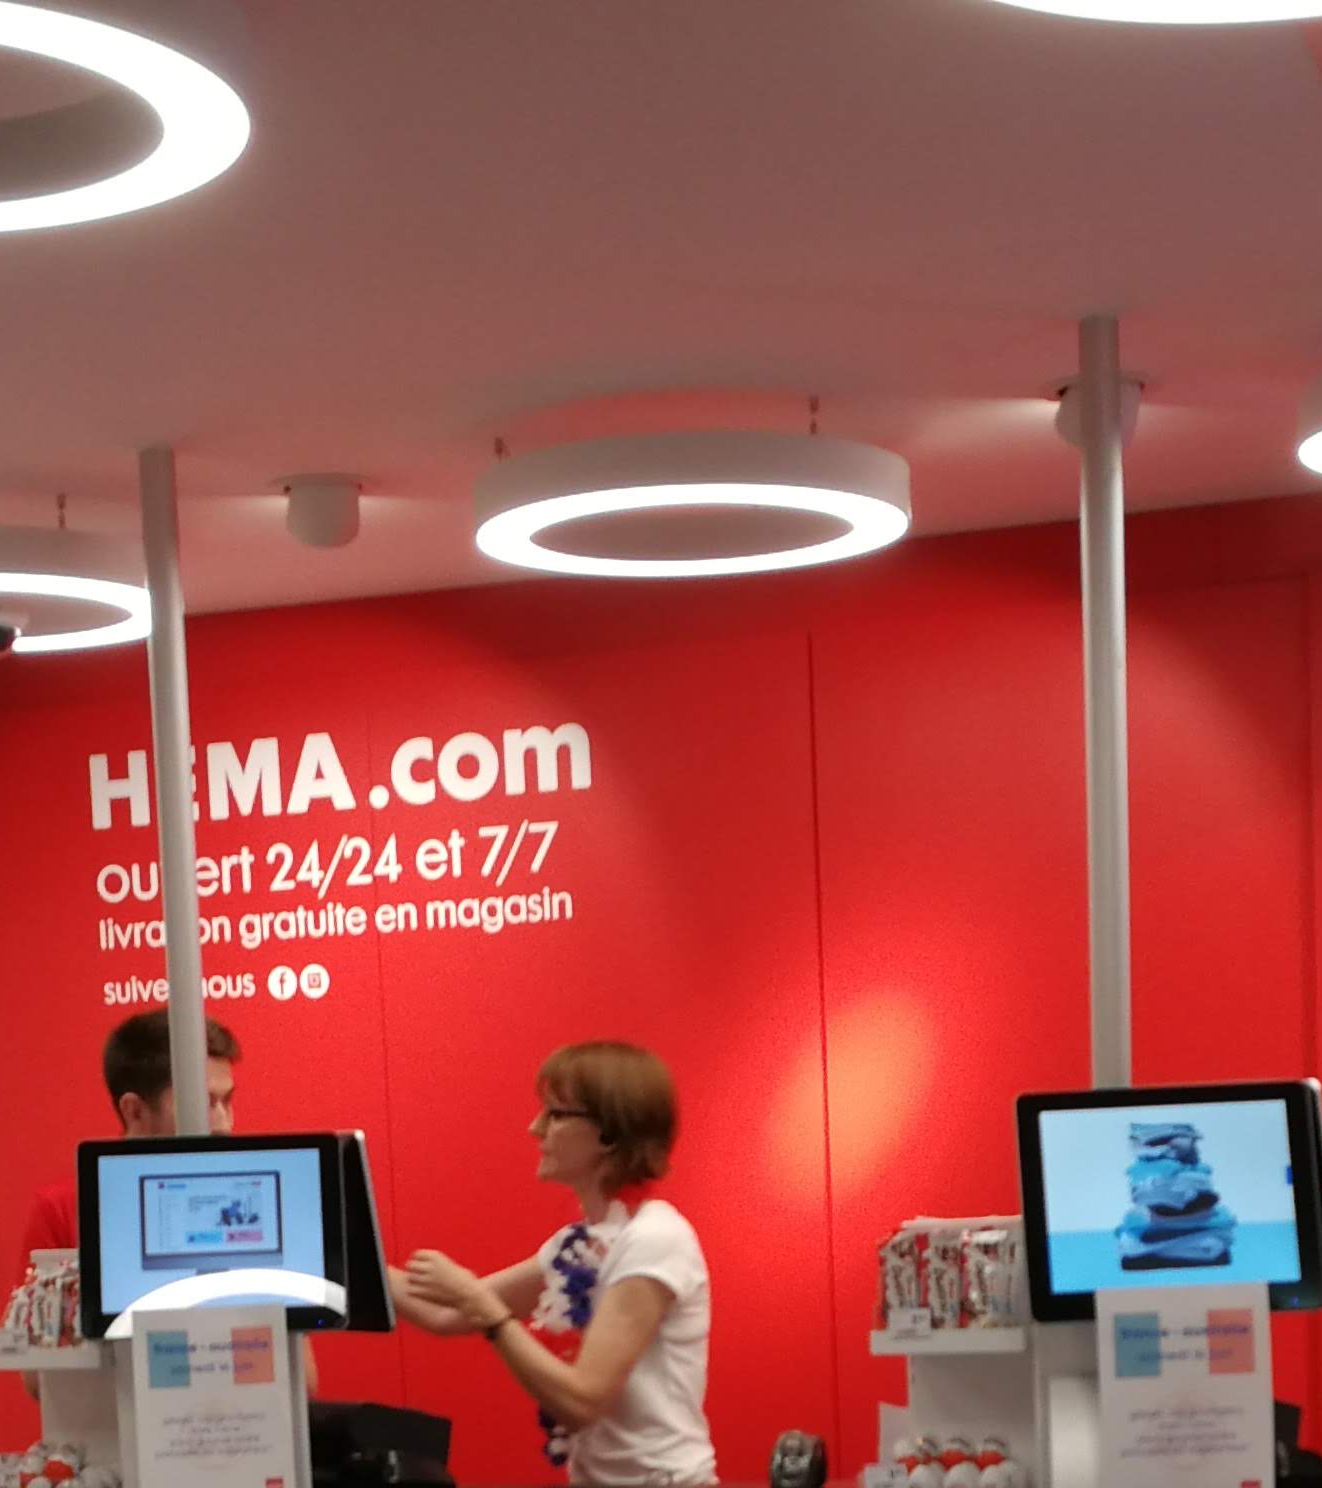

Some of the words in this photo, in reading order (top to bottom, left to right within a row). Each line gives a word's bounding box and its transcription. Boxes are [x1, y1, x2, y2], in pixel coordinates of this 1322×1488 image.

[88, 720, 592, 831] HMA.com
[96, 846, 255, 904] ouert
[265, 832, 402, 900] 24/24
[415, 829, 465, 882] et
[477, 819, 559, 887] 7/7
[98, 916, 232, 951] livraon
[238, 898, 368, 951] gratuite
[375, 899, 418, 933] en
[425, 886, 574, 935] magasin
